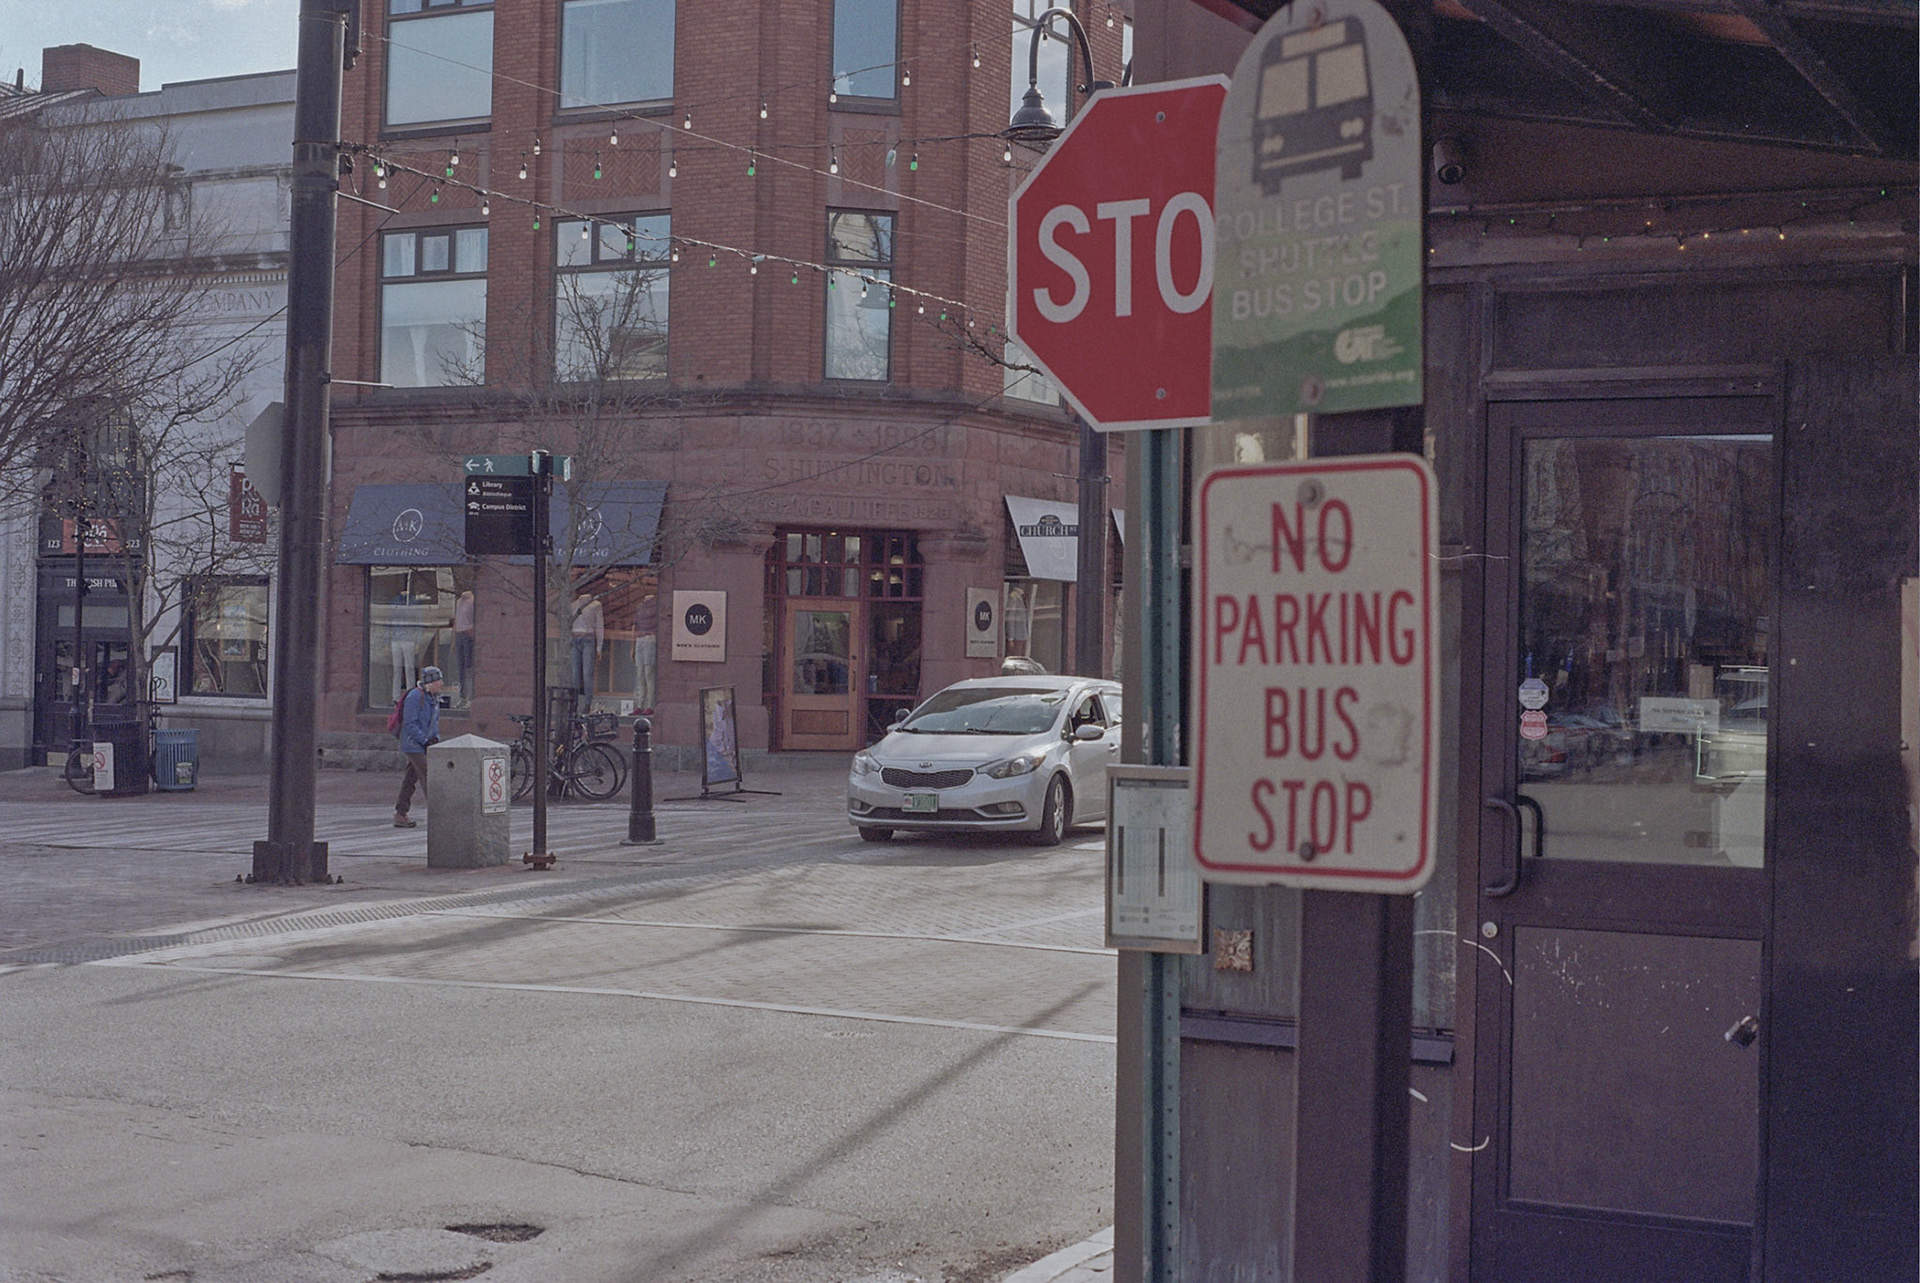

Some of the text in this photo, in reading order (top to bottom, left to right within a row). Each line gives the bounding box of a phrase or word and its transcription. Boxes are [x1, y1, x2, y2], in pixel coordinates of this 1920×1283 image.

[1215, 182, 1410, 242] COLLEGE ST.
[1033, 192, 1215, 323] STO
[1231, 270, 1387, 322] BUS STOP
[482, 481, 502, 489] Library
[481, 503, 526, 511] Campus District
[396, 519, 419, 532] MK
[1020, 525, 1069, 537] CHURCH
[1271, 499, 1353, 575] NO
[47, 540, 61, 549] 123
[373, 547, 430, 557] CLOTHING
[688, 614, 707, 626] MK
[979, 611, 991, 621] MK
[1213, 590, 1416, 666] PARKING
[1264, 685, 1360, 762] BUS
[1248, 777, 1374, 856] STOP
